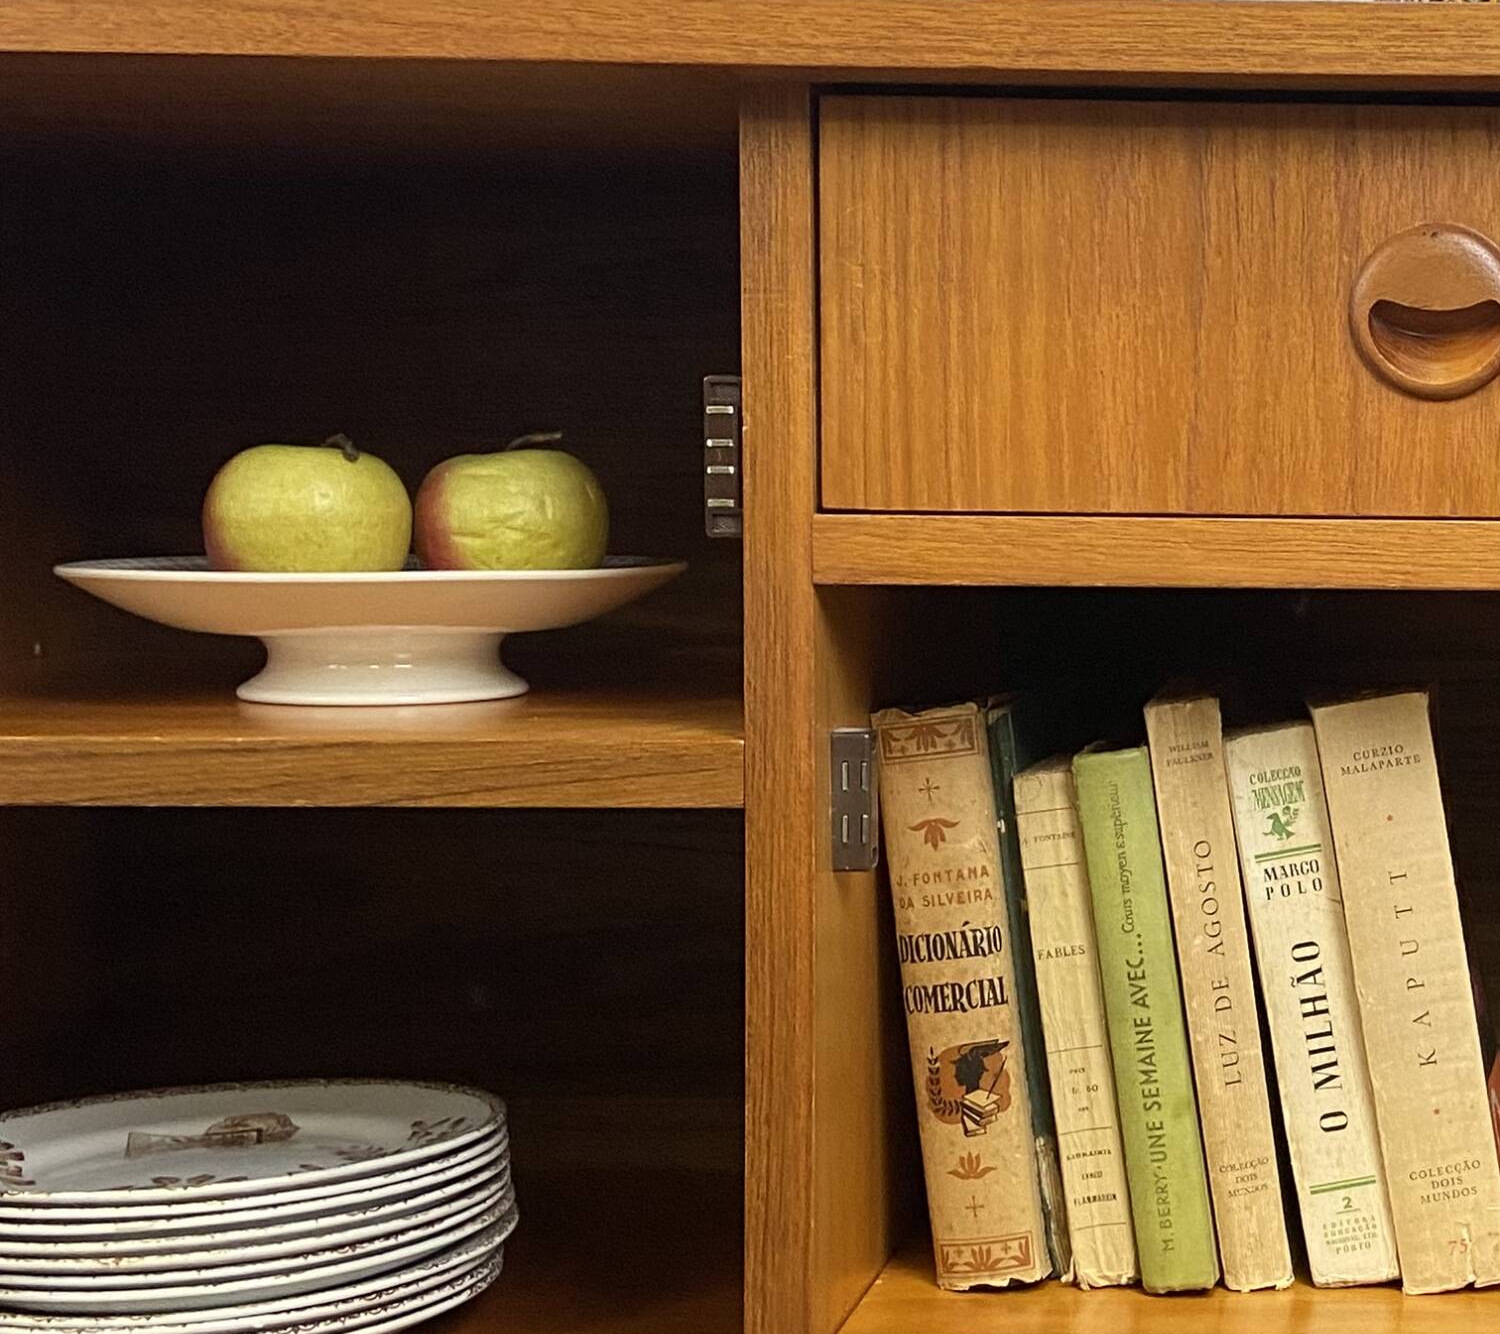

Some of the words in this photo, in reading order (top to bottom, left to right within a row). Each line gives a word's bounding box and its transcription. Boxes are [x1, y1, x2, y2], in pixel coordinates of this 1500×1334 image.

[1340, 754, 1421, 776] MALAPARTE
[1353, 744, 1404, 761] CURZIO
[913, 865, 990, 886] FONTANA
[1118, 851, 1133, 895] moyen
[1263, 858, 1320, 883] MARCO
[922, 888, 993, 907] SILVEIRA
[1194, 839, 1225, 957] AGOSTO
[1266, 877, 1323, 900] POLO
[1121, 899, 1134, 934] Cours
[899, 920, 1002, 964] DICIONÁRIO
[1037, 944, 1086, 960] FABLES
[1387, 871, 1438, 1068] KAPUTT
[904, 976, 1009, 1015] COMERCIAL
[1212, 976, 1233, 1013] DE
[1289, 940, 1343, 1092] MILHÃO
[1134, 1017, 1161, 1112] SEMAINE
[1218, 1029, 1242, 1087] LUZ
[1319, 1110, 1349, 1133] O
[1420, 1186, 1478, 1204] MUNDOS
[1431, 1176, 1464, 1189] DOIS
[1342, 1196, 1353, 1209] 2
